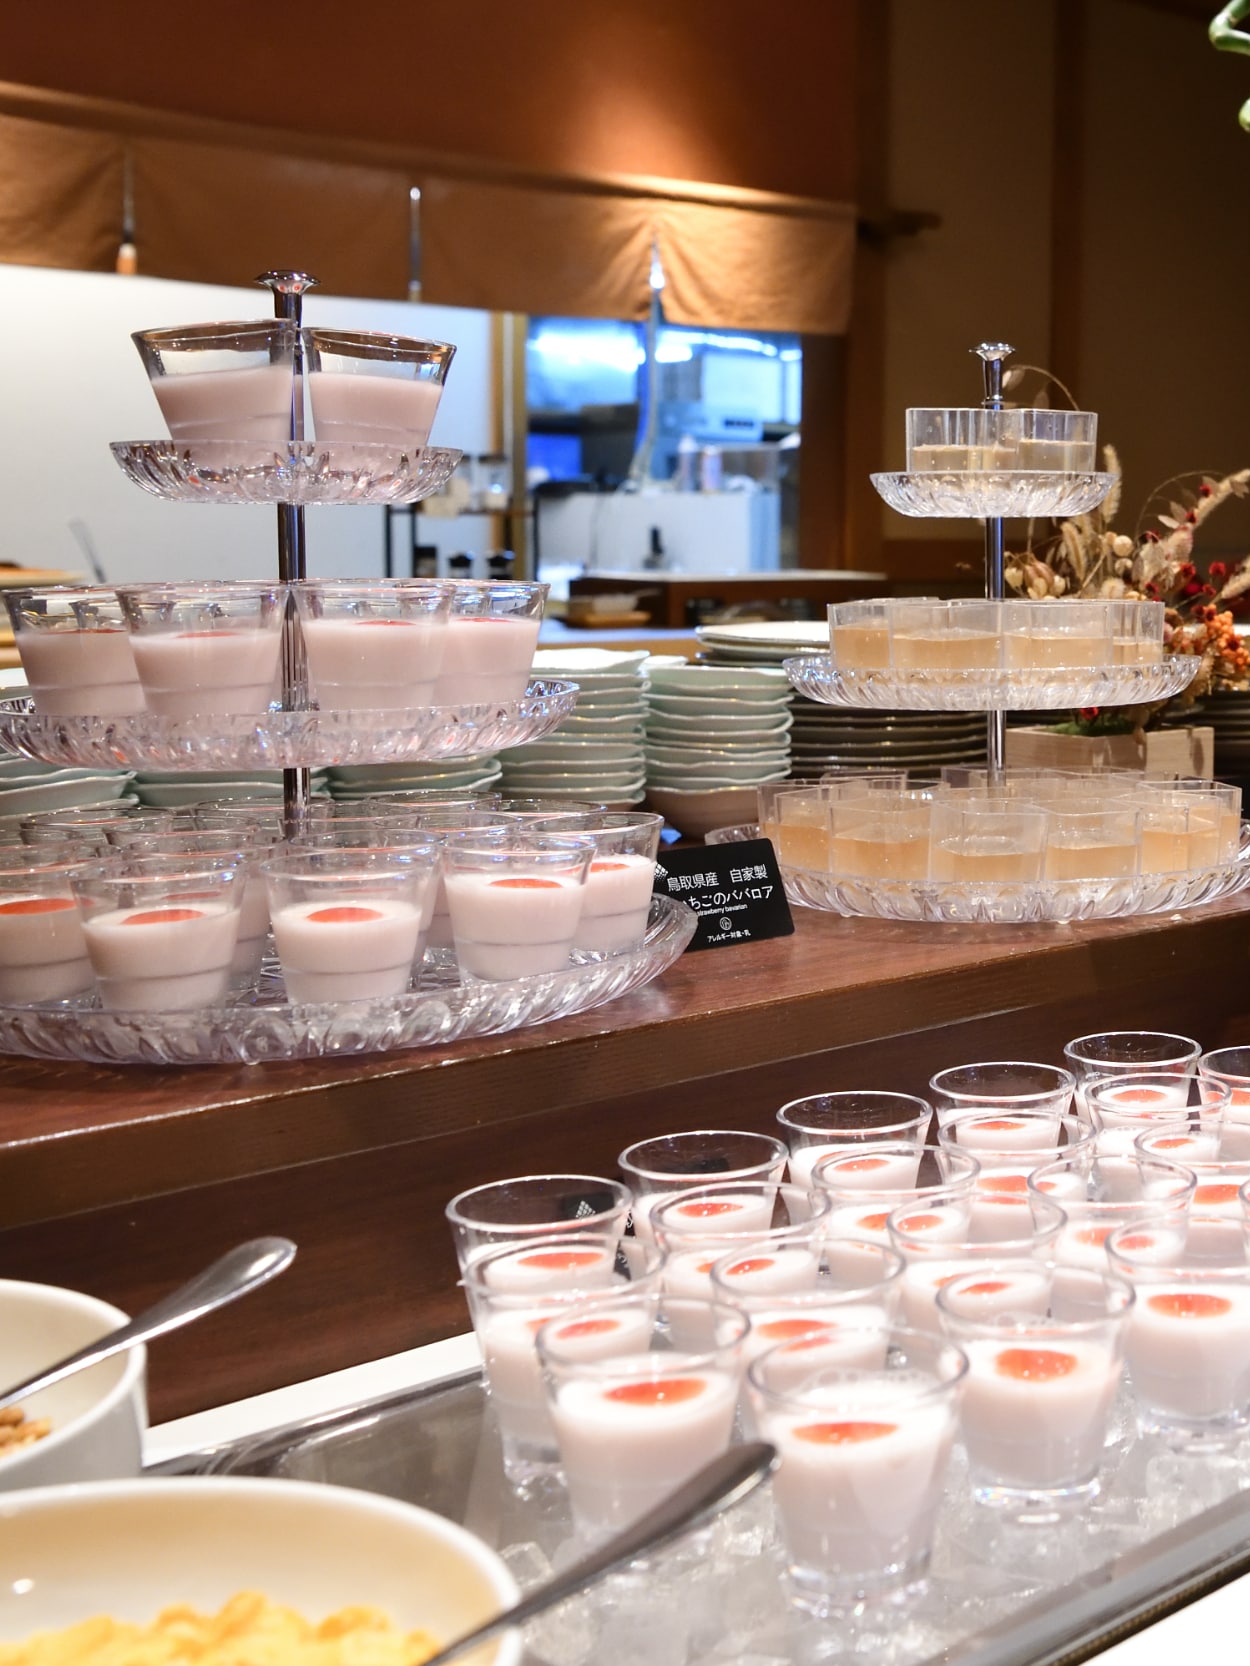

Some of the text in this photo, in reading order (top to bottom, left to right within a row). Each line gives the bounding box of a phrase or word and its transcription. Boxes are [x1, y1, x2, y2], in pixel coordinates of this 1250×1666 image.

[667, 864, 768, 892] 鳥取県産 自家製
